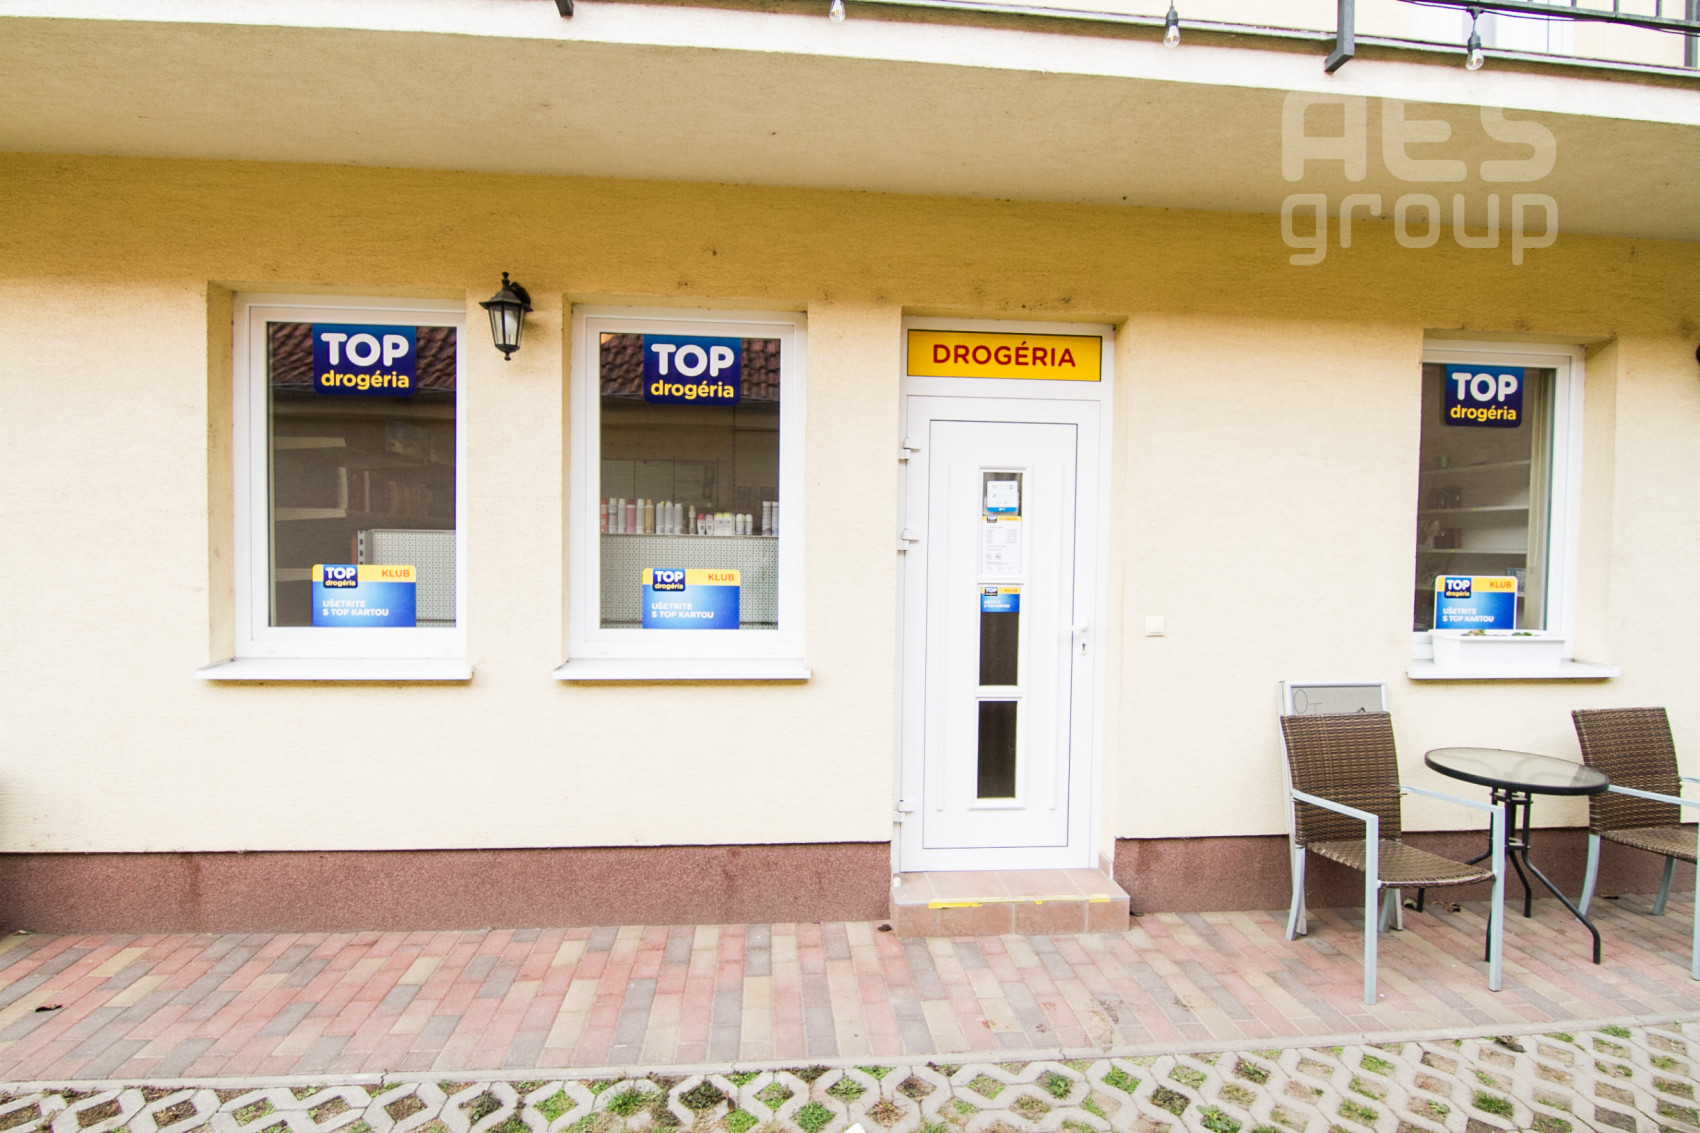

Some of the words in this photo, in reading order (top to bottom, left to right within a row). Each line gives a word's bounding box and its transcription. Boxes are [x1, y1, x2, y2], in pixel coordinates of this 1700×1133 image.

[320, 332, 410, 367] TOP
[933, 341, 1076, 368] DROGÉRIA
[650, 343, 735, 377] TOP
[320, 370, 410, 390] drogéria
[650, 379, 734, 400] drogéria
[1451, 372, 1518, 402] TOP
[1450, 404, 1517, 422] drogéria
[325, 567, 356, 579] TOP
[381, 569, 410, 578] KLUB
[654, 570, 684, 582] TOP
[707, 573, 735, 581] KLUB
[325, 579, 356, 587] drogéria
[1446, 579, 1471, 590] TOP
[322, 599, 366, 607] UŠETRITE
[651, 602, 693, 610] UŠETRITE
[322, 608, 328, 616] S
[331, 608, 350, 616] TOP
[351, 608, 389, 617] KARTOU
[678, 611, 715, 619] KARTOU
